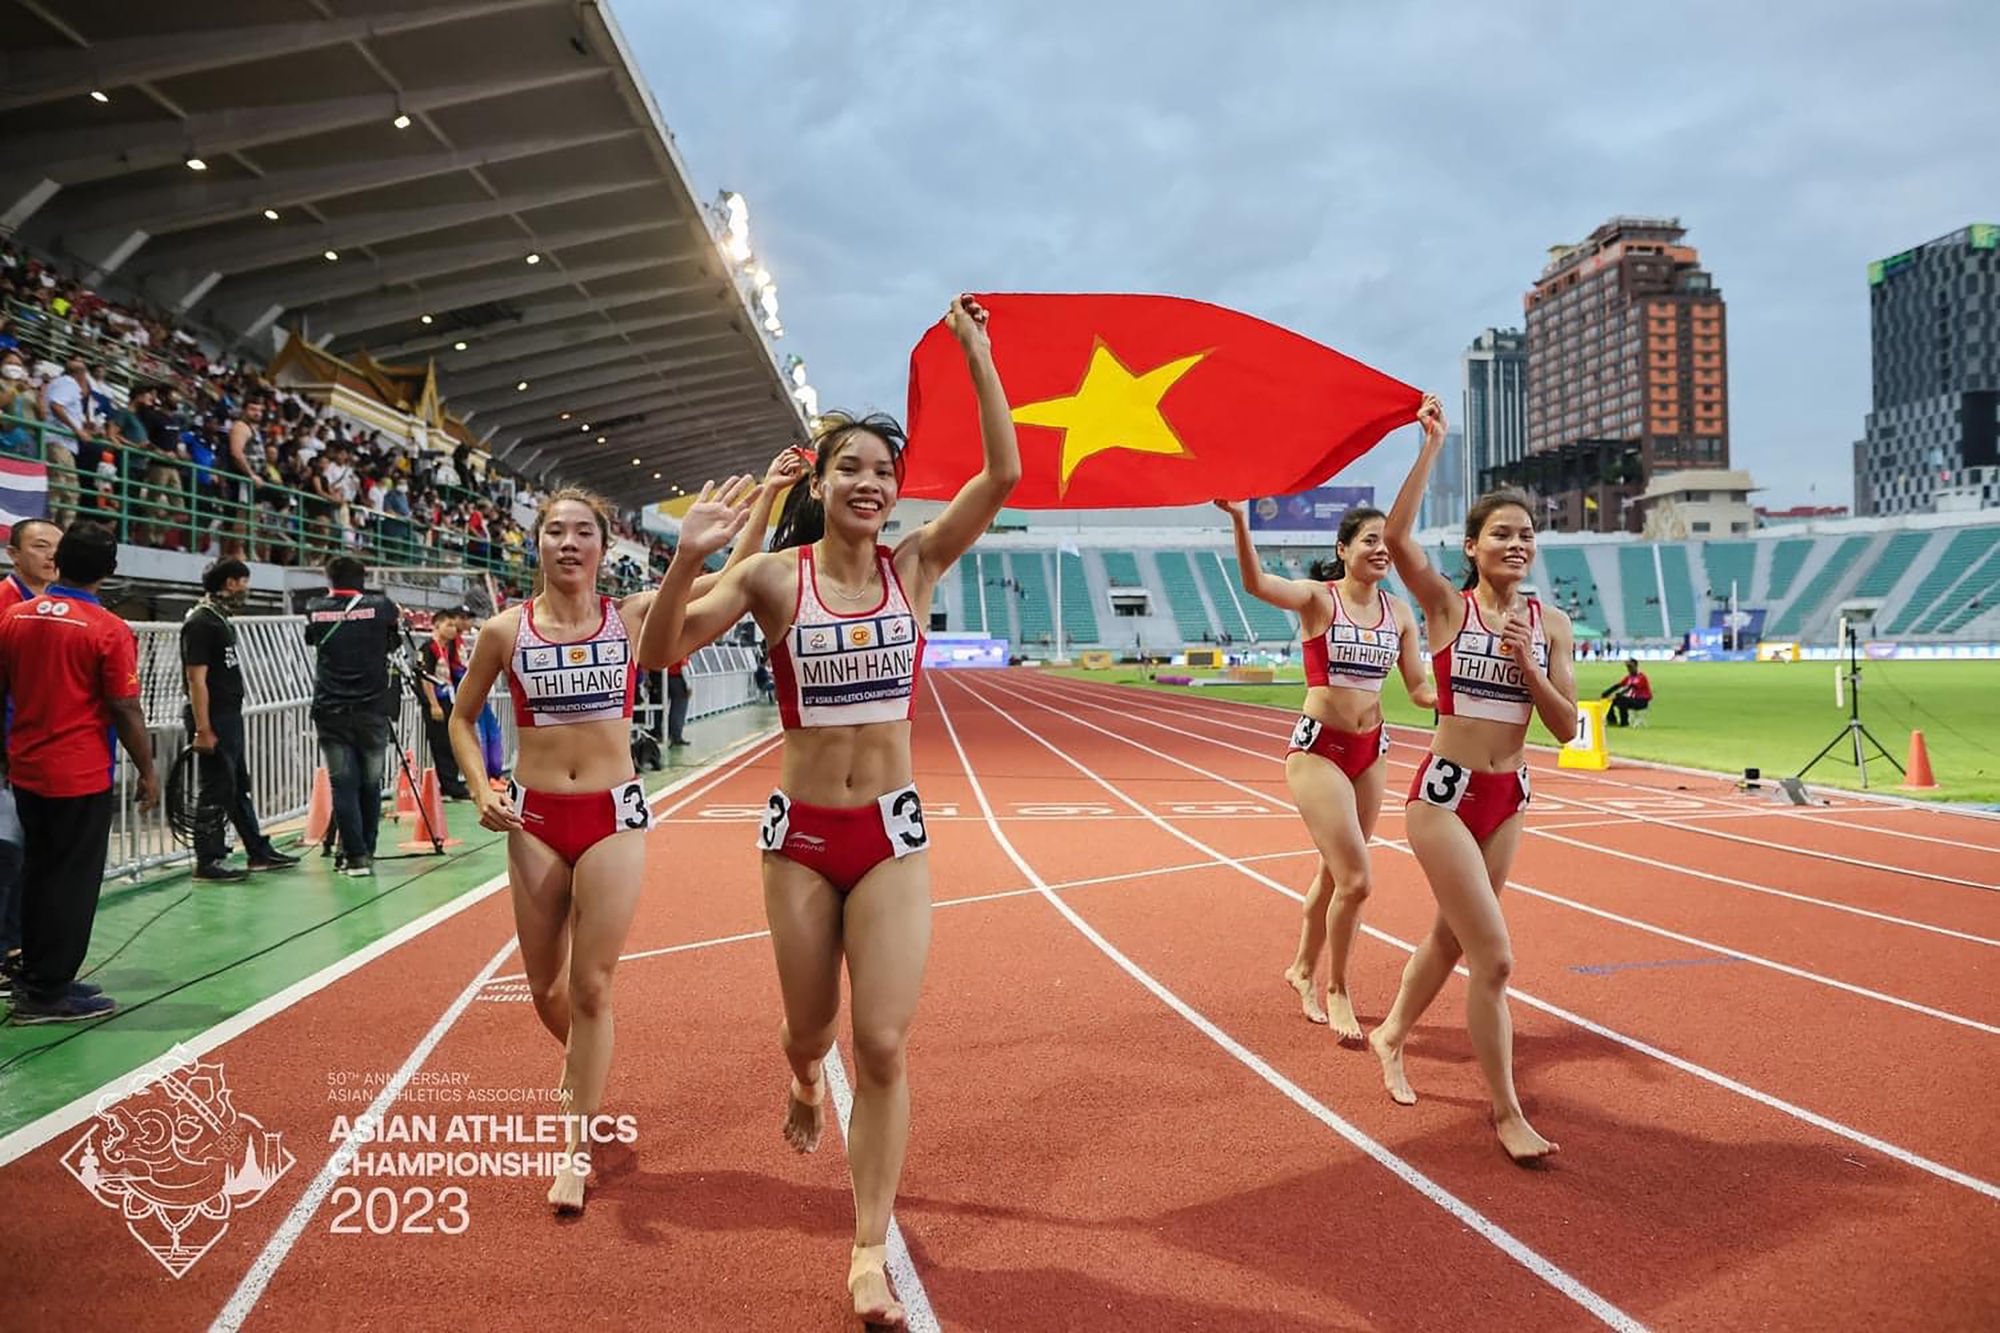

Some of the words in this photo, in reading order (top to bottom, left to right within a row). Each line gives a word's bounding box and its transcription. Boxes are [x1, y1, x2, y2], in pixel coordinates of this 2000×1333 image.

[1336, 645, 1357, 662] THI
[1457, 656, 1487, 679] THI
[532, 674, 564, 696] THI
[571, 668, 623, 694] HANG
[803, 656, 859, 684] MINH
[1294, 715, 1316, 747] 3
[1578, 717, 1586, 740] 1
[1427, 758, 1462, 804] 3
[623, 784, 649, 829] 3
[763, 794, 786, 848] 3
[892, 790, 928, 848] 3
